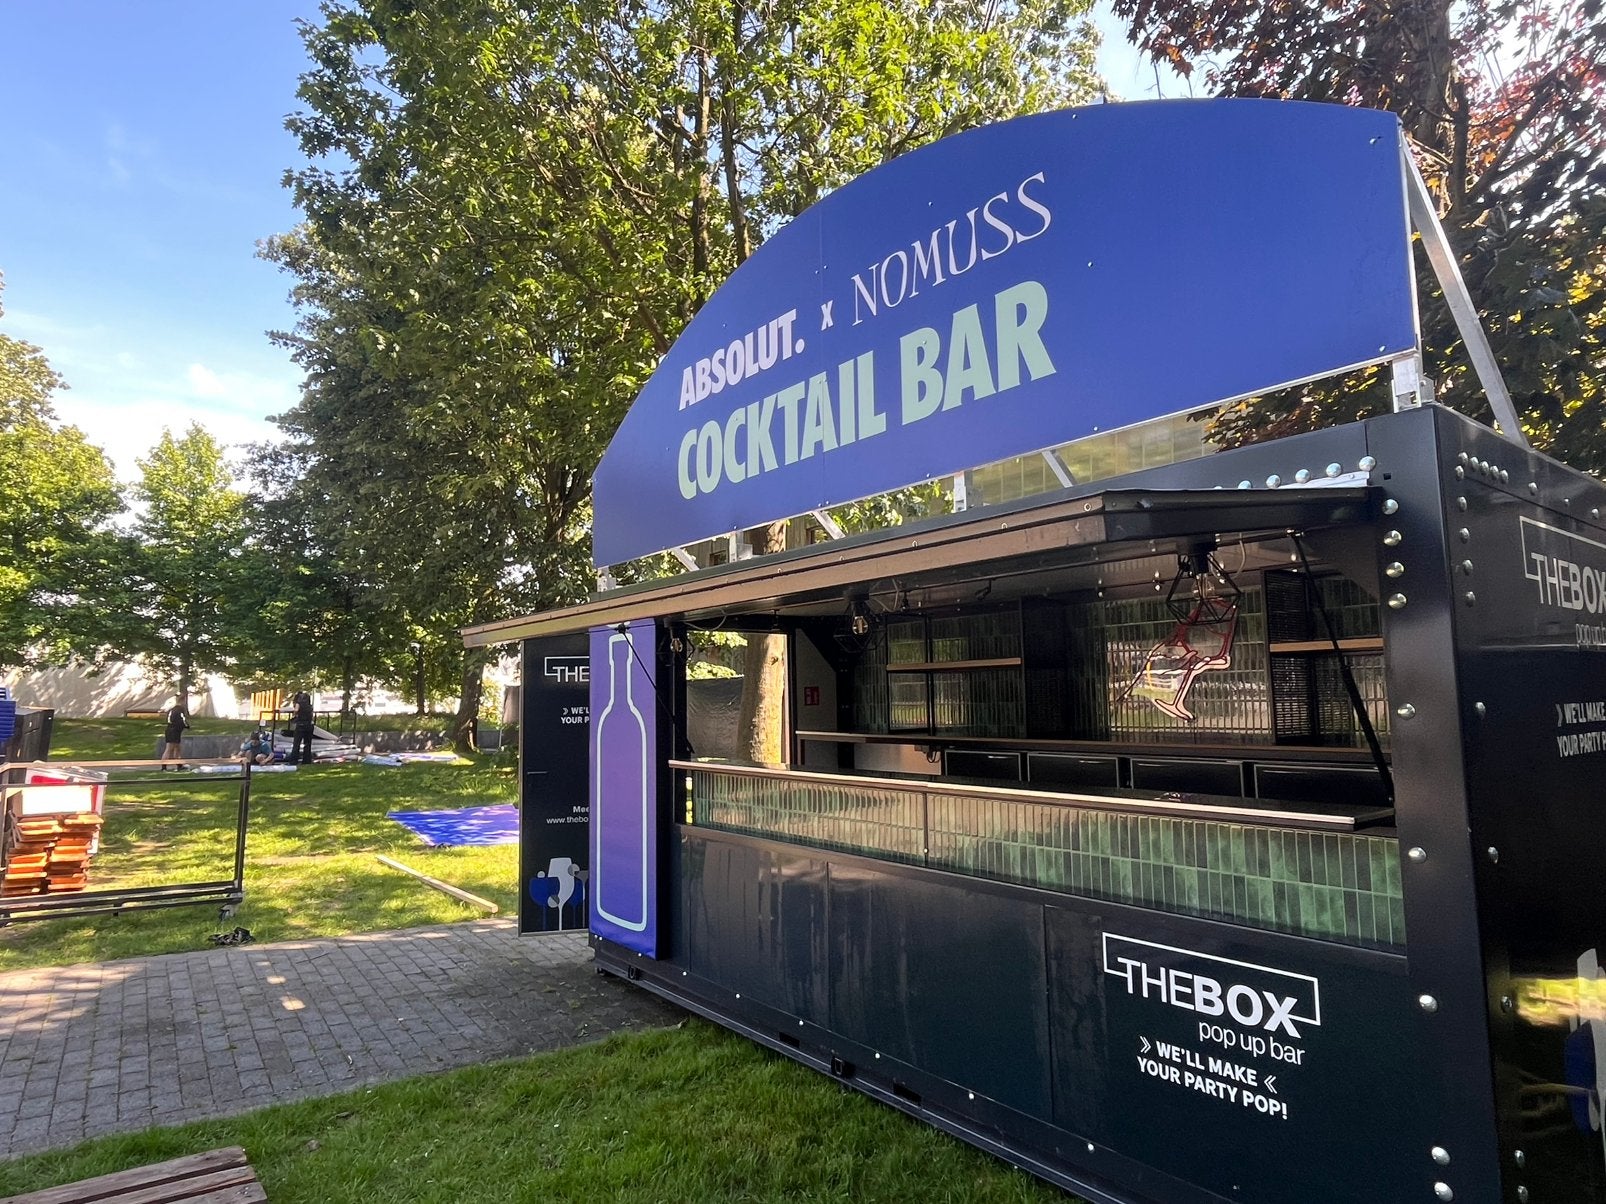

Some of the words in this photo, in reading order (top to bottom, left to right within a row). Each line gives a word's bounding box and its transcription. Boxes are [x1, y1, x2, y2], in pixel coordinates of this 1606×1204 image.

[679, 309, 806, 411] ABSOLUT.
[851, 171, 1052, 327] NOMUSS
[678, 350, 887, 500] COCKTAIL
[899, 281, 1057, 427] BAR
[560, 716, 583, 724] YOUR
[1557, 735, 1580, 758] YOUR
[1579, 731, 1601, 754] PARTY
[1117, 957, 1302, 1039] THEBOX
[1155, 1040, 1205, 1071] WE'LL
[1208, 1056, 1259, 1087] MAKE
[1198, 1021, 1236, 1049] pop
[1239, 1032, 1266, 1058] up
[1269, 1036, 1306, 1066] bar
[1136, 1055, 1182, 1085] YOUR
[1184, 1070, 1239, 1104] PARTY
[1242, 1089, 1288, 1120] POP!
